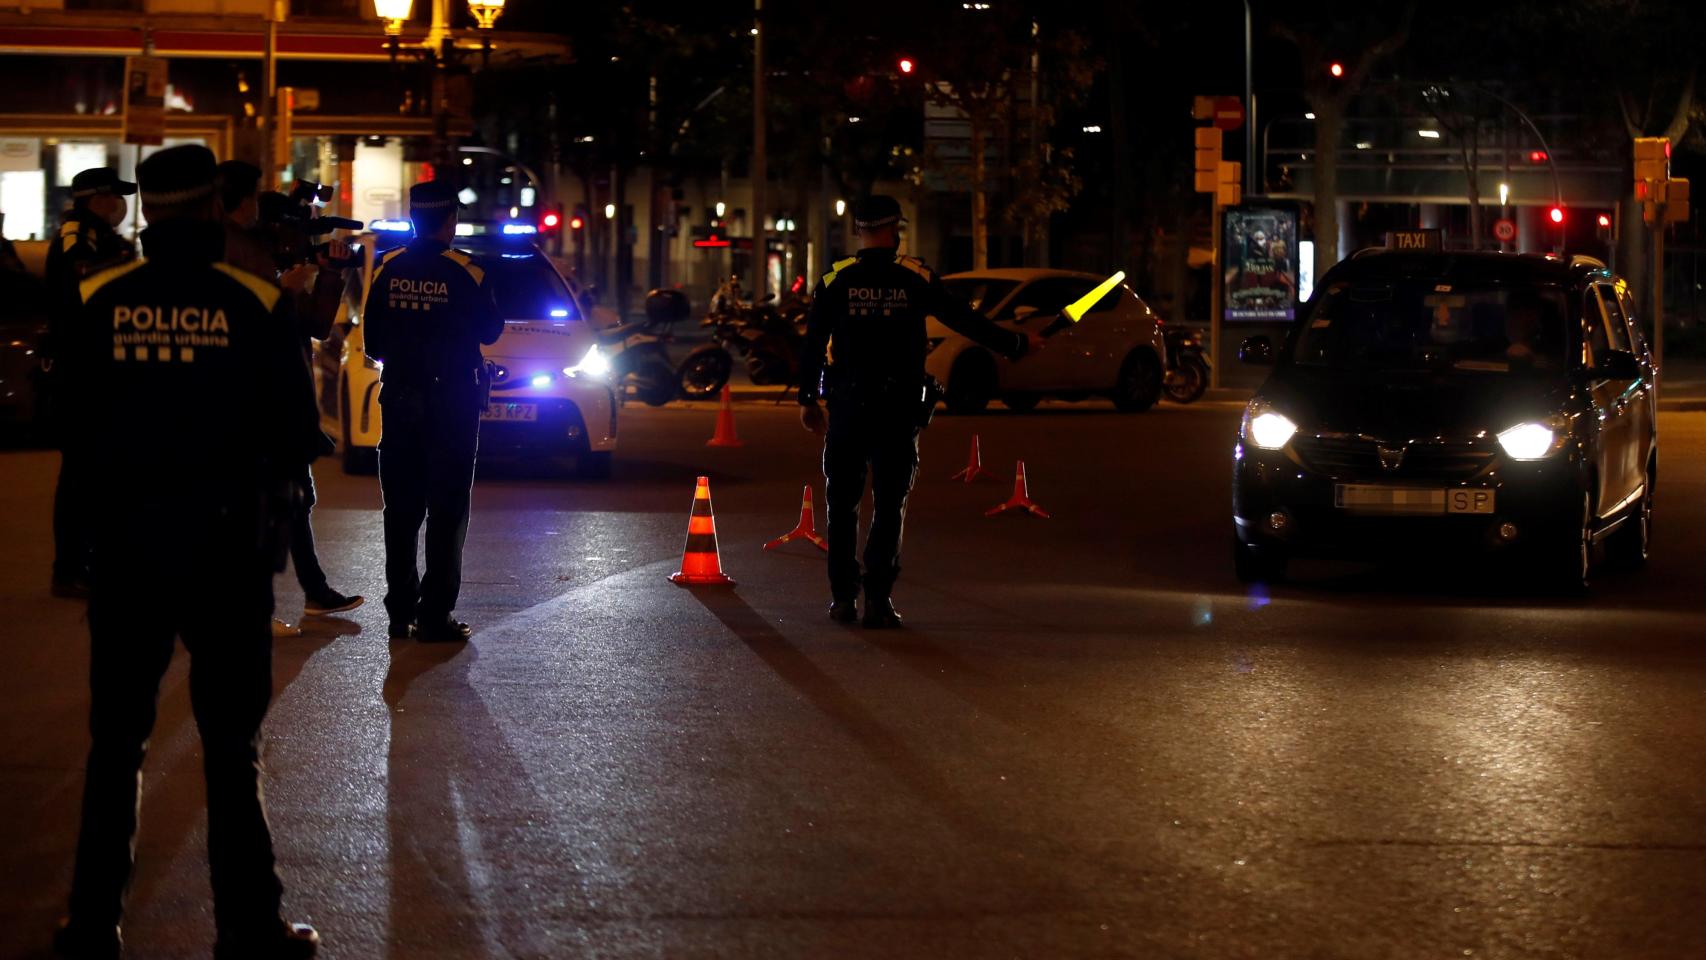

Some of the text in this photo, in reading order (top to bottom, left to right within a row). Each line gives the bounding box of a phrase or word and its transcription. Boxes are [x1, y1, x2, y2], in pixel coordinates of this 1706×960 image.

[1395, 232, 1426, 249] TAXI
[389, 277, 448, 295] POLICIA
[848, 287, 908, 301] POLICIA
[113, 304, 230, 333] POLICIA
[174, 332, 230, 348] urbana
[1453, 491, 1489, 511] SP
